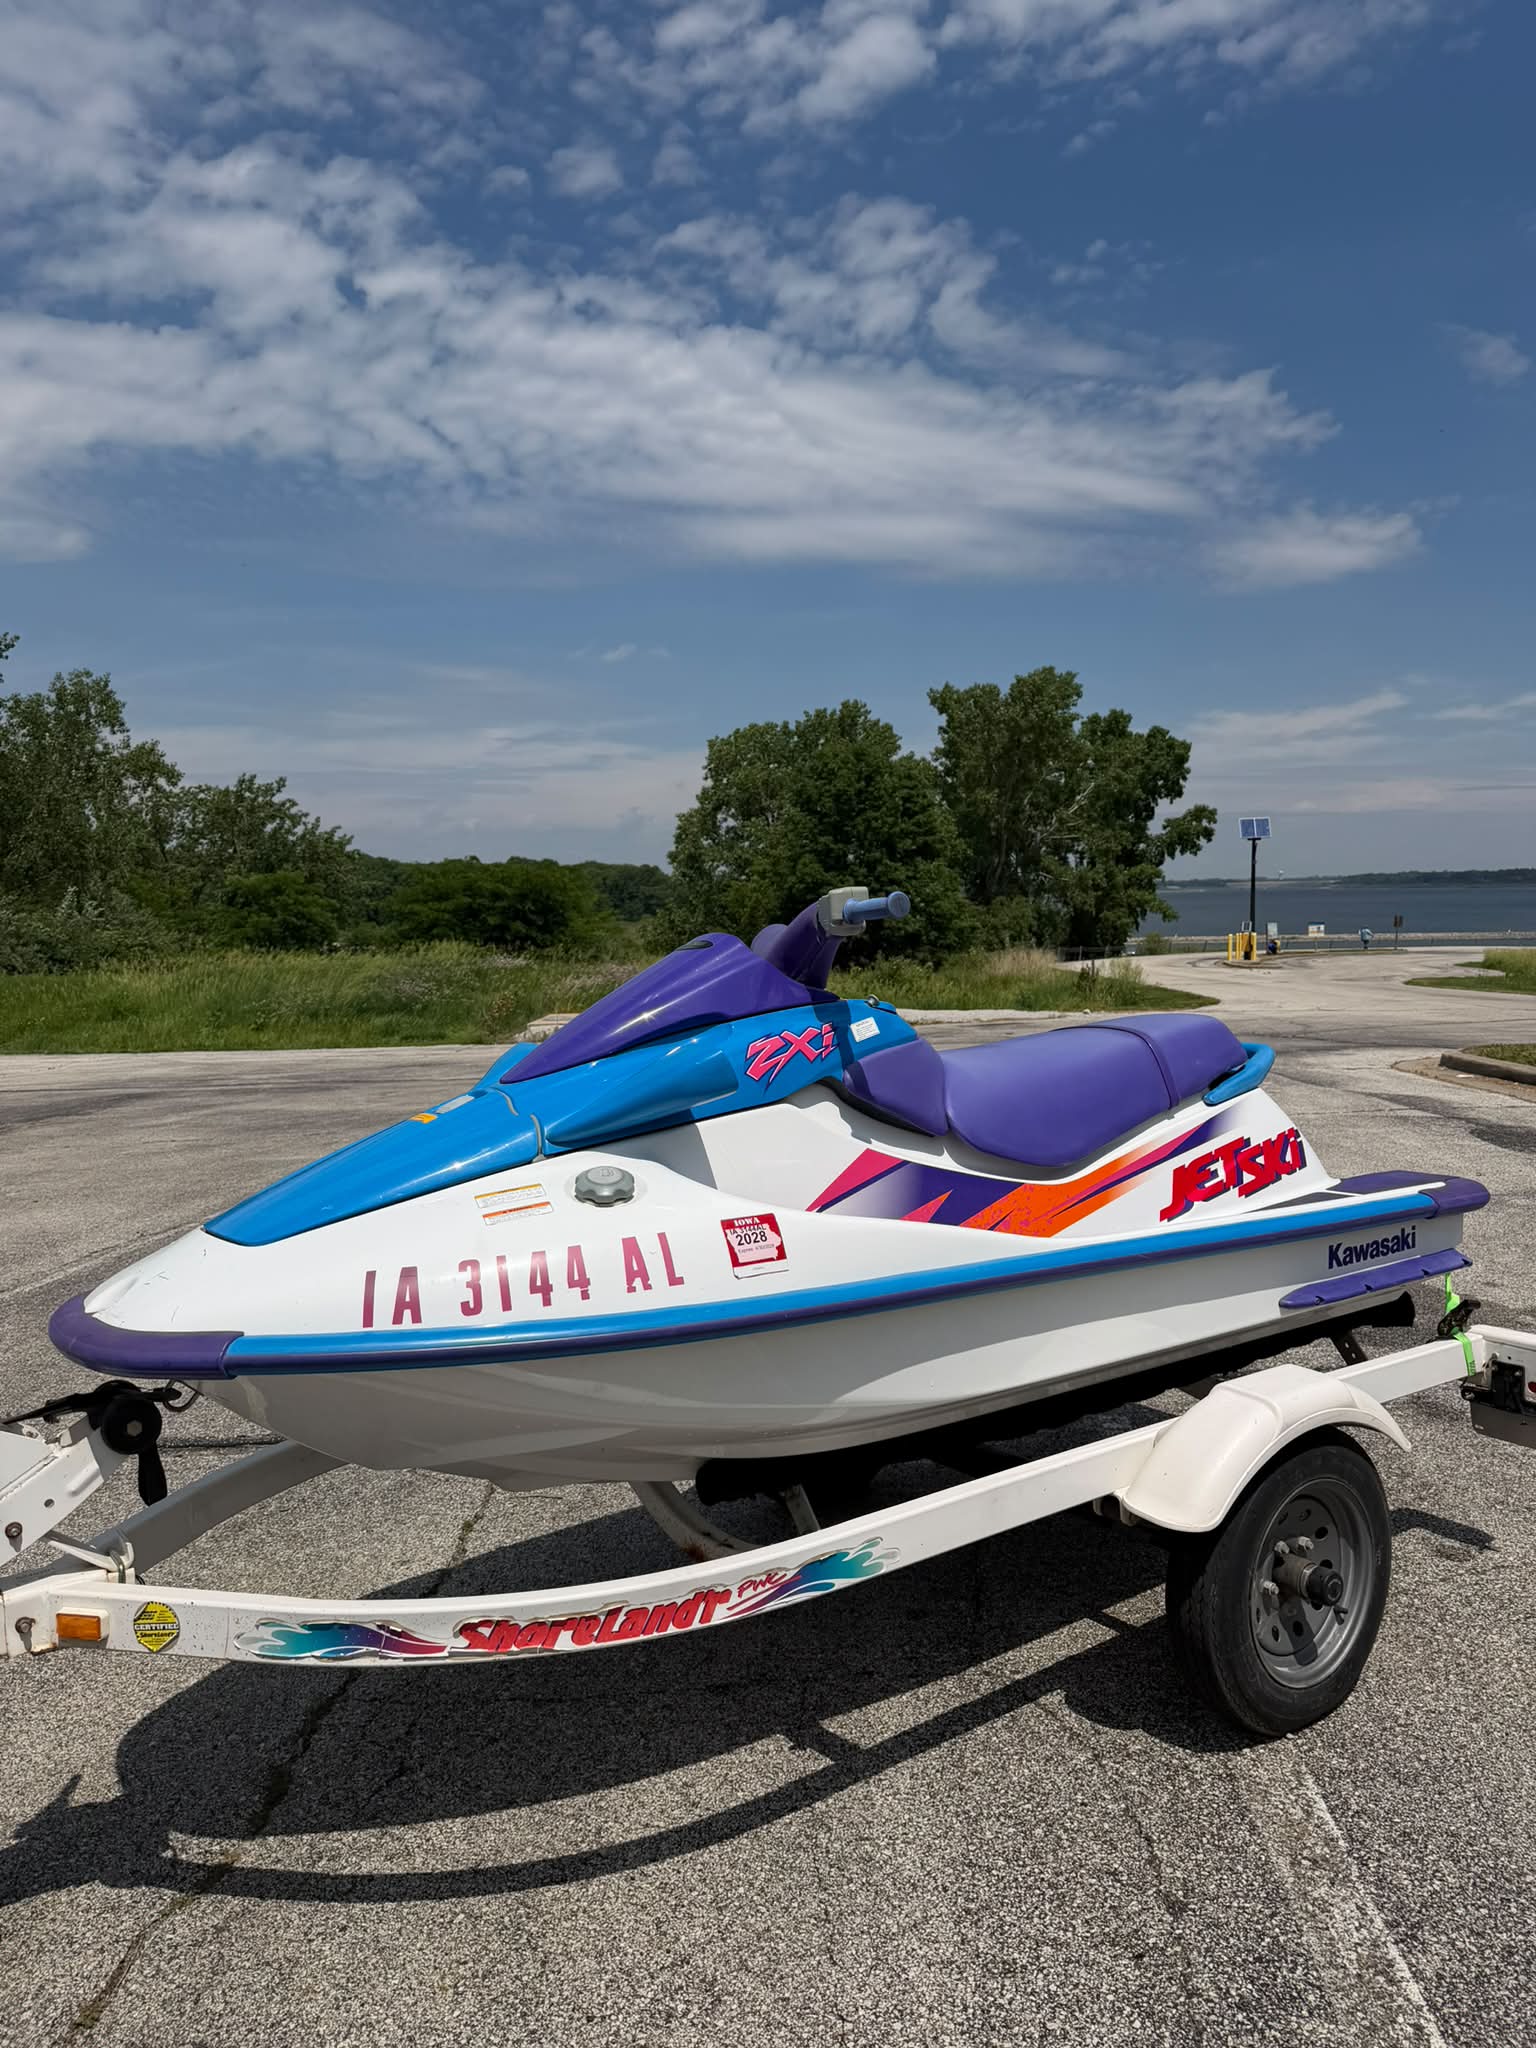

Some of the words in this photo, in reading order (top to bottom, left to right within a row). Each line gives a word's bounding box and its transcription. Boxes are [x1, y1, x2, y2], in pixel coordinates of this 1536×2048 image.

[733, 1216, 760, 1228] IOWA
[735, 1230, 768, 1246] 2028
[1328, 1225, 1416, 1270] Kawasaki
[362, 1266, 422, 1328] IA
[458, 1244, 591, 1317] 3144
[621, 1232, 685, 1294] AL
[737, 1571, 787, 1599] PWC
